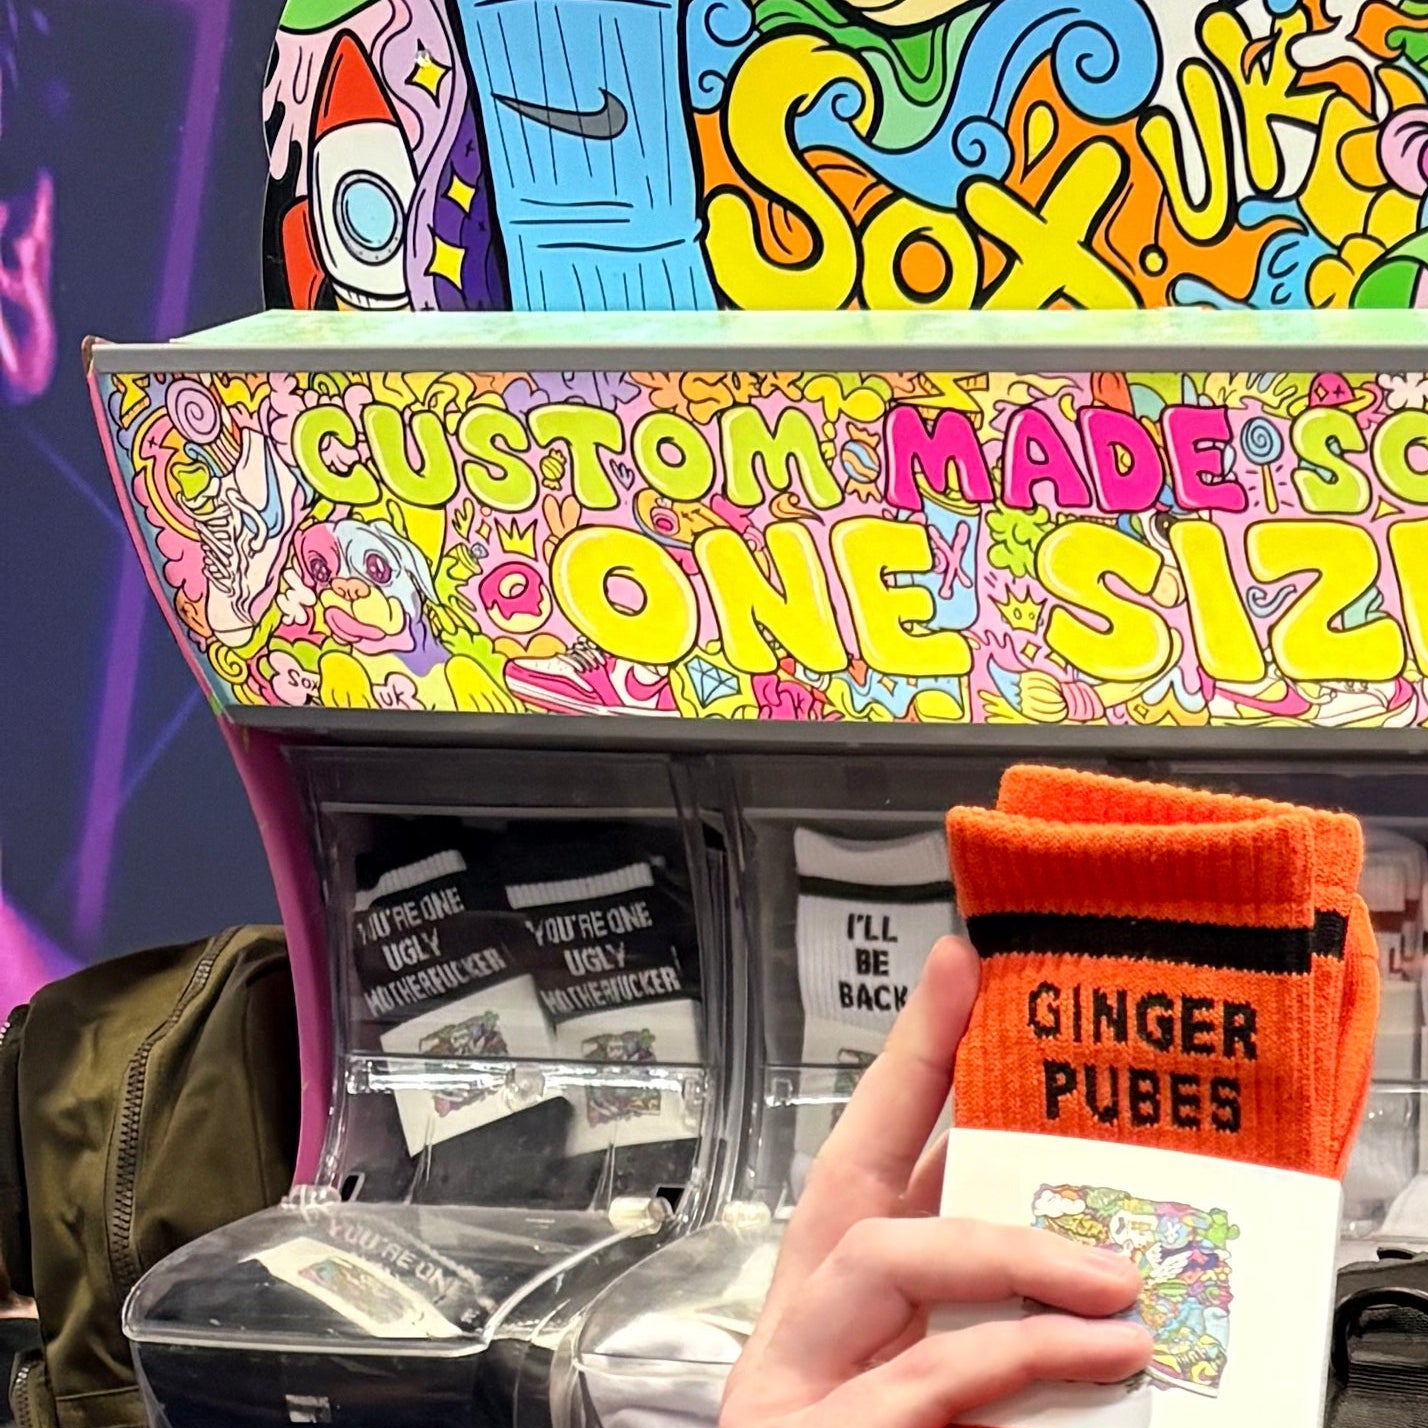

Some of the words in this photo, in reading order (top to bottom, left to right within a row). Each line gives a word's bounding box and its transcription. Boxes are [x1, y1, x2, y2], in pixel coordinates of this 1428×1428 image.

[290, 403, 844, 510] CUSTOM
[884, 403, 1248, 513] MADE
[551, 514, 974, 681] ONE
[419, 886, 466, 921] ONE
[524, 911, 599, 948] YOU'RE
[599, 900, 653, 934] ONE
[382, 927, 441, 972] UGLY
[846, 912, 899, 943] I'LL
[561, 940, 627, 978] UGLY
[855, 948, 890, 977] BE
[363, 947, 507, 1019] MOTHERFUCKER
[838, 979, 908, 1013] BACK
[1026, 980, 1260, 1061] GINGER
[1041, 1058, 1244, 1134] PUBES
